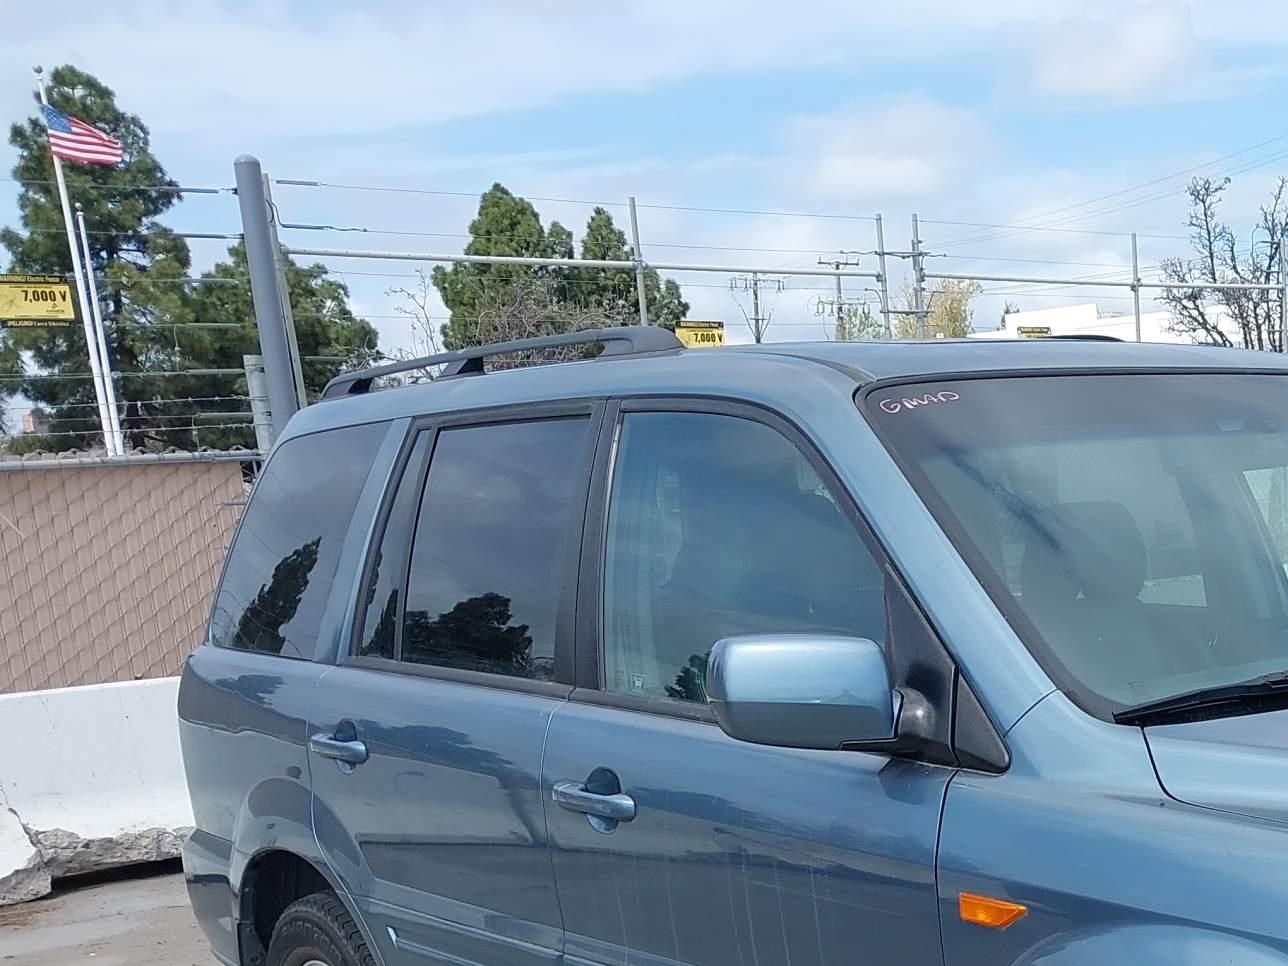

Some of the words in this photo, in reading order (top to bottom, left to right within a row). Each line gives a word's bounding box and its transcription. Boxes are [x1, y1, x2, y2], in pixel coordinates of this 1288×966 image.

[21, 289, 57, 304] 7,000
[58, 290, 67, 302] V
[693, 333, 716, 344] 7,000
[717, 332, 723, 343] V
